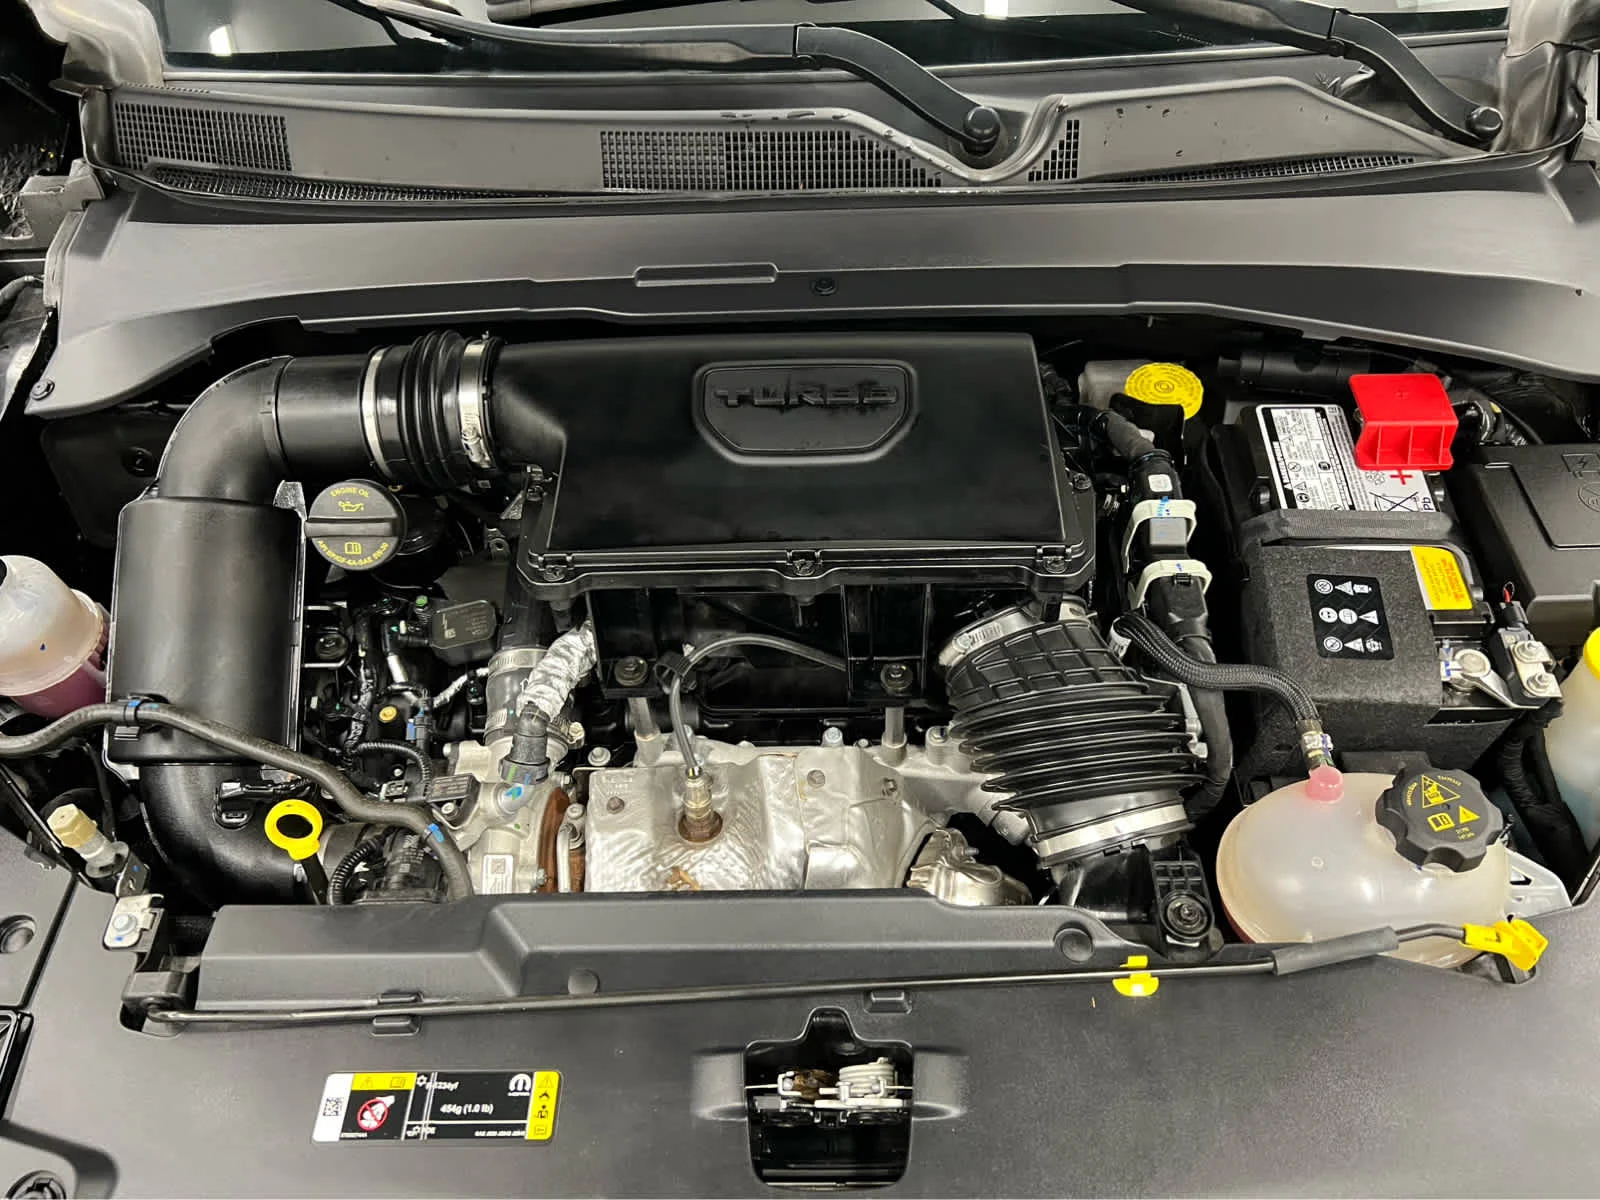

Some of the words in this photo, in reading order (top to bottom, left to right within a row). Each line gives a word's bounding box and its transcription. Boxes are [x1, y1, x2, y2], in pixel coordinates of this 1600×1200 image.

[1422, 496, 1435, 511] Pb
[463, 1103, 481, 1115] (1.0
[481, 1103, 494, 1115] lb)
